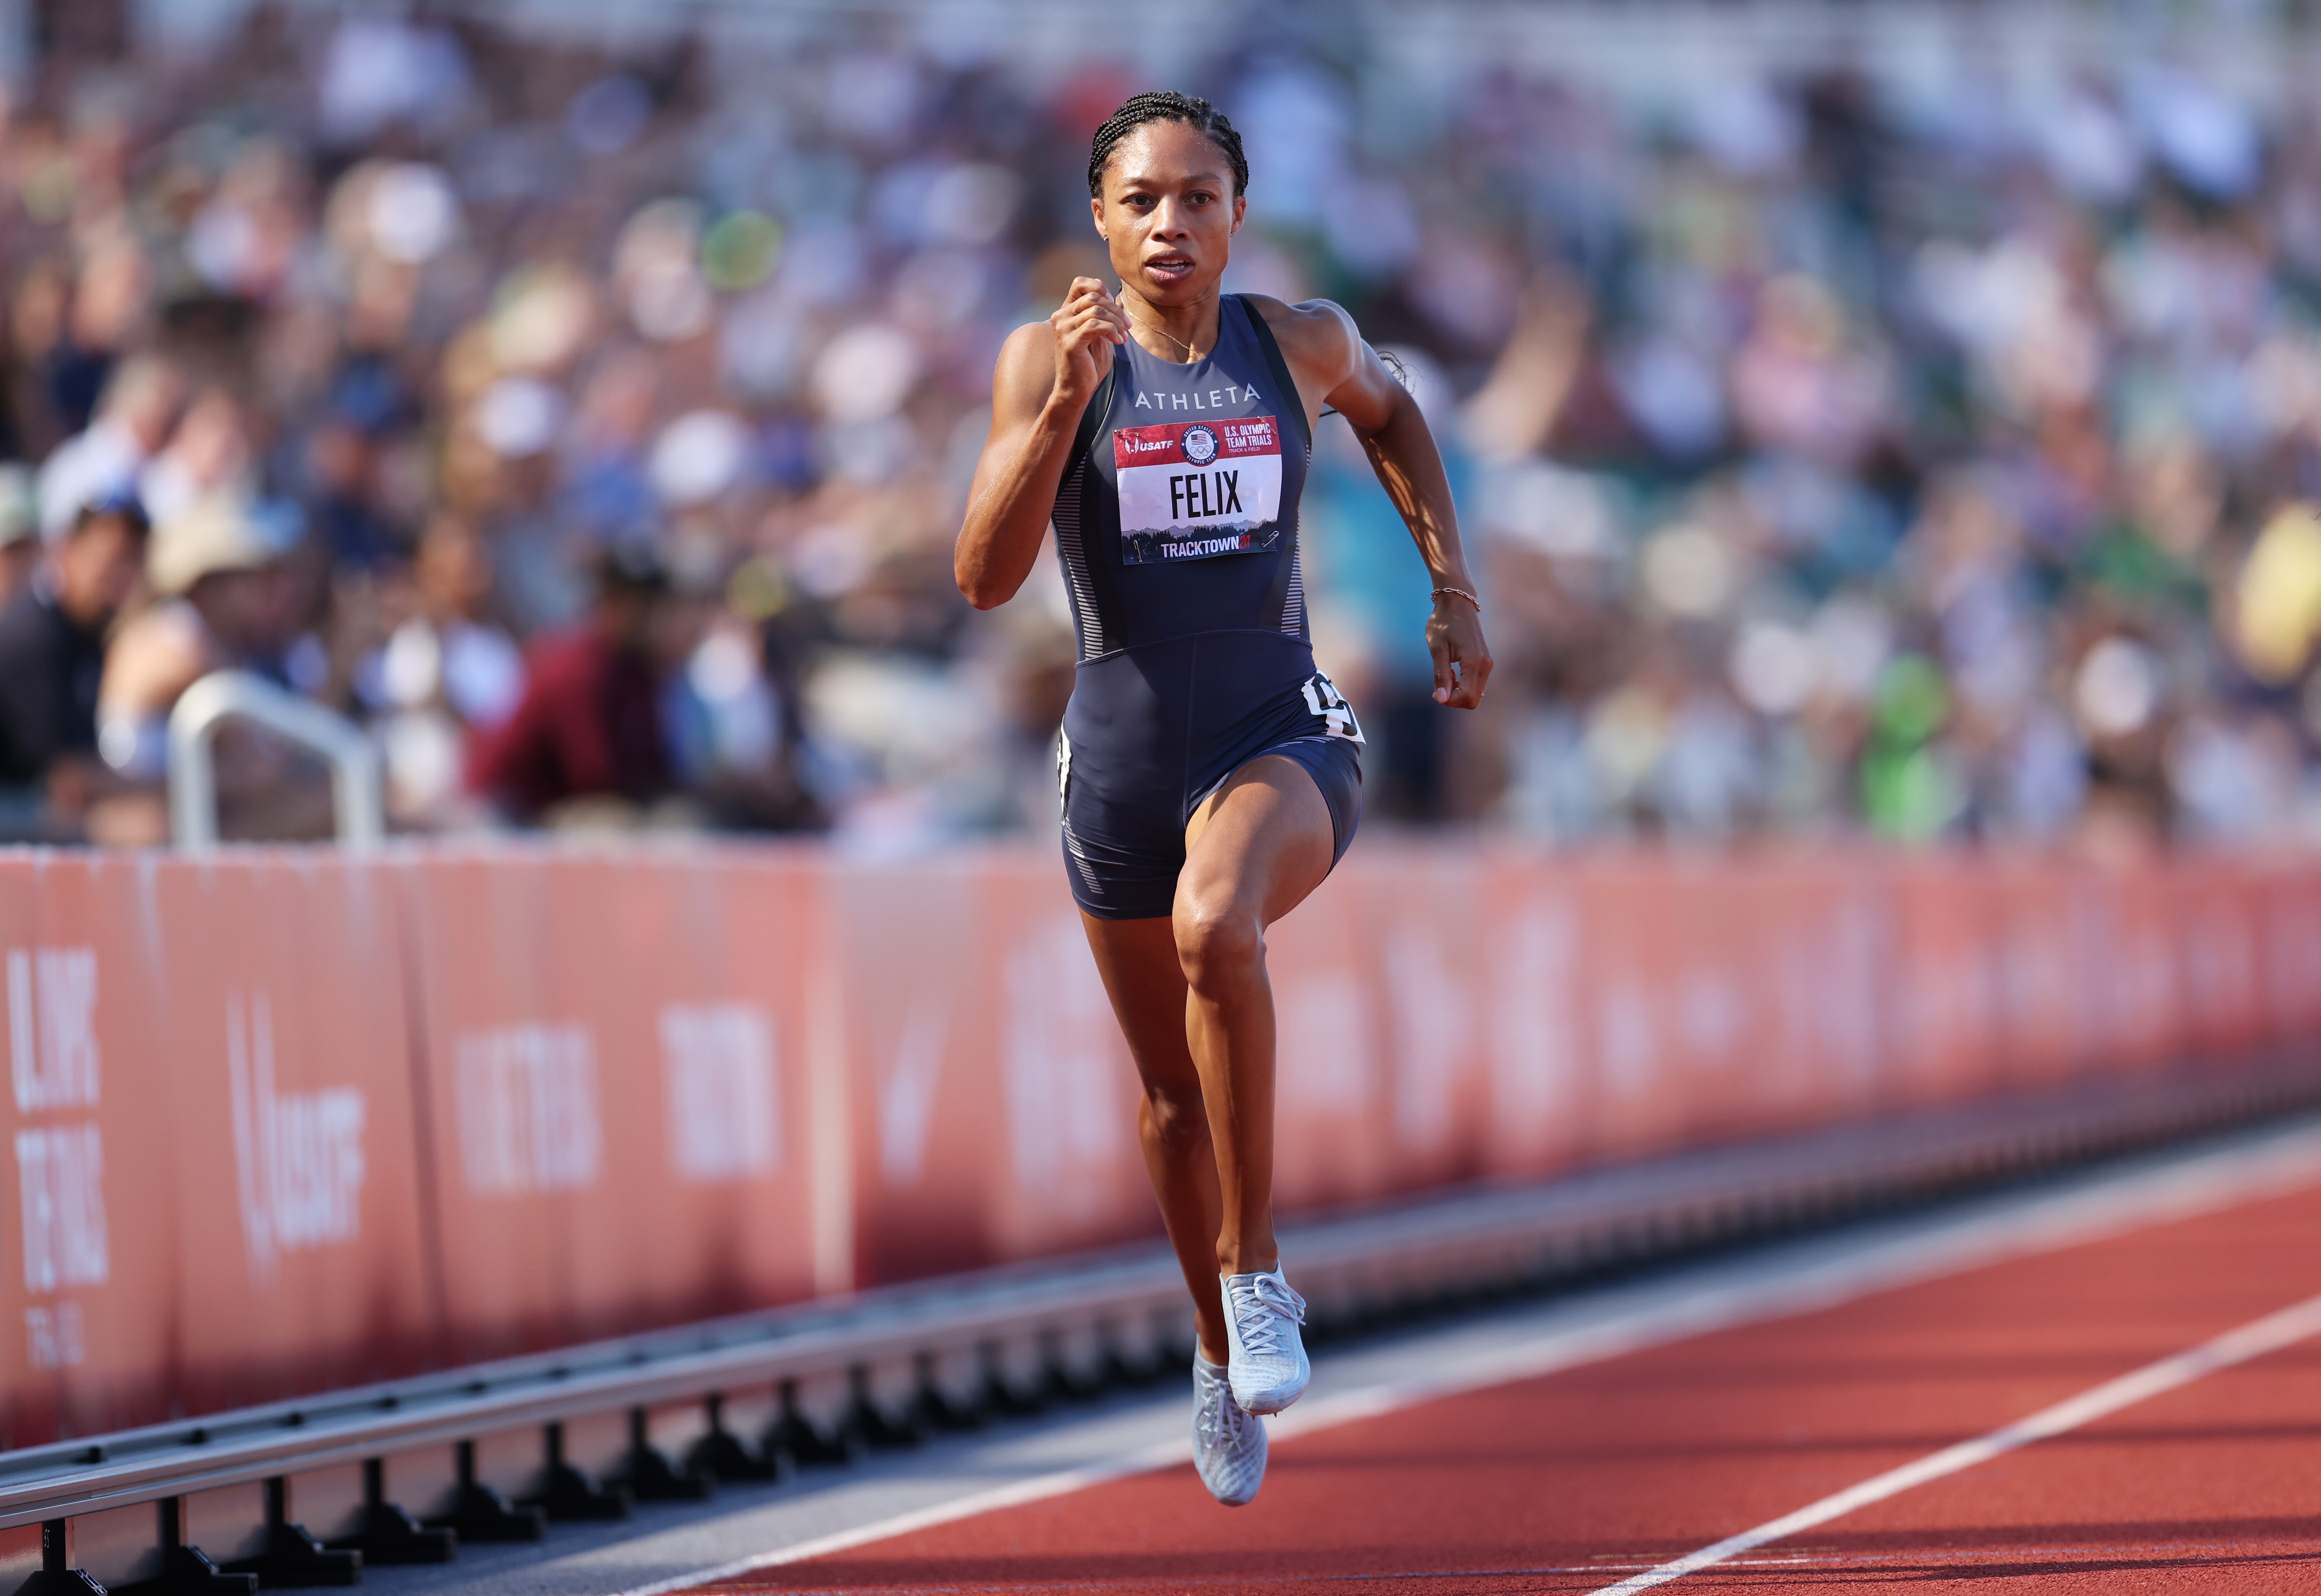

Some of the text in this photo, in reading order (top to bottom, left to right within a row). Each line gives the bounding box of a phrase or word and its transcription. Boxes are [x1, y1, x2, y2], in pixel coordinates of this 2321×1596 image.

[1135, 382, 1261, 410] ATHLETA
[1183, 425, 1213, 437] UNITED STATES
[1224, 423, 1271, 437] U.S. OLYMPIC
[1140, 440, 1173, 452] USATF
[1226, 434, 1272, 448] TEAM TRIALS
[1186, 453, 1216, 465] OLYMPIC TEAM
[1170, 470, 1243, 519] FELIX
